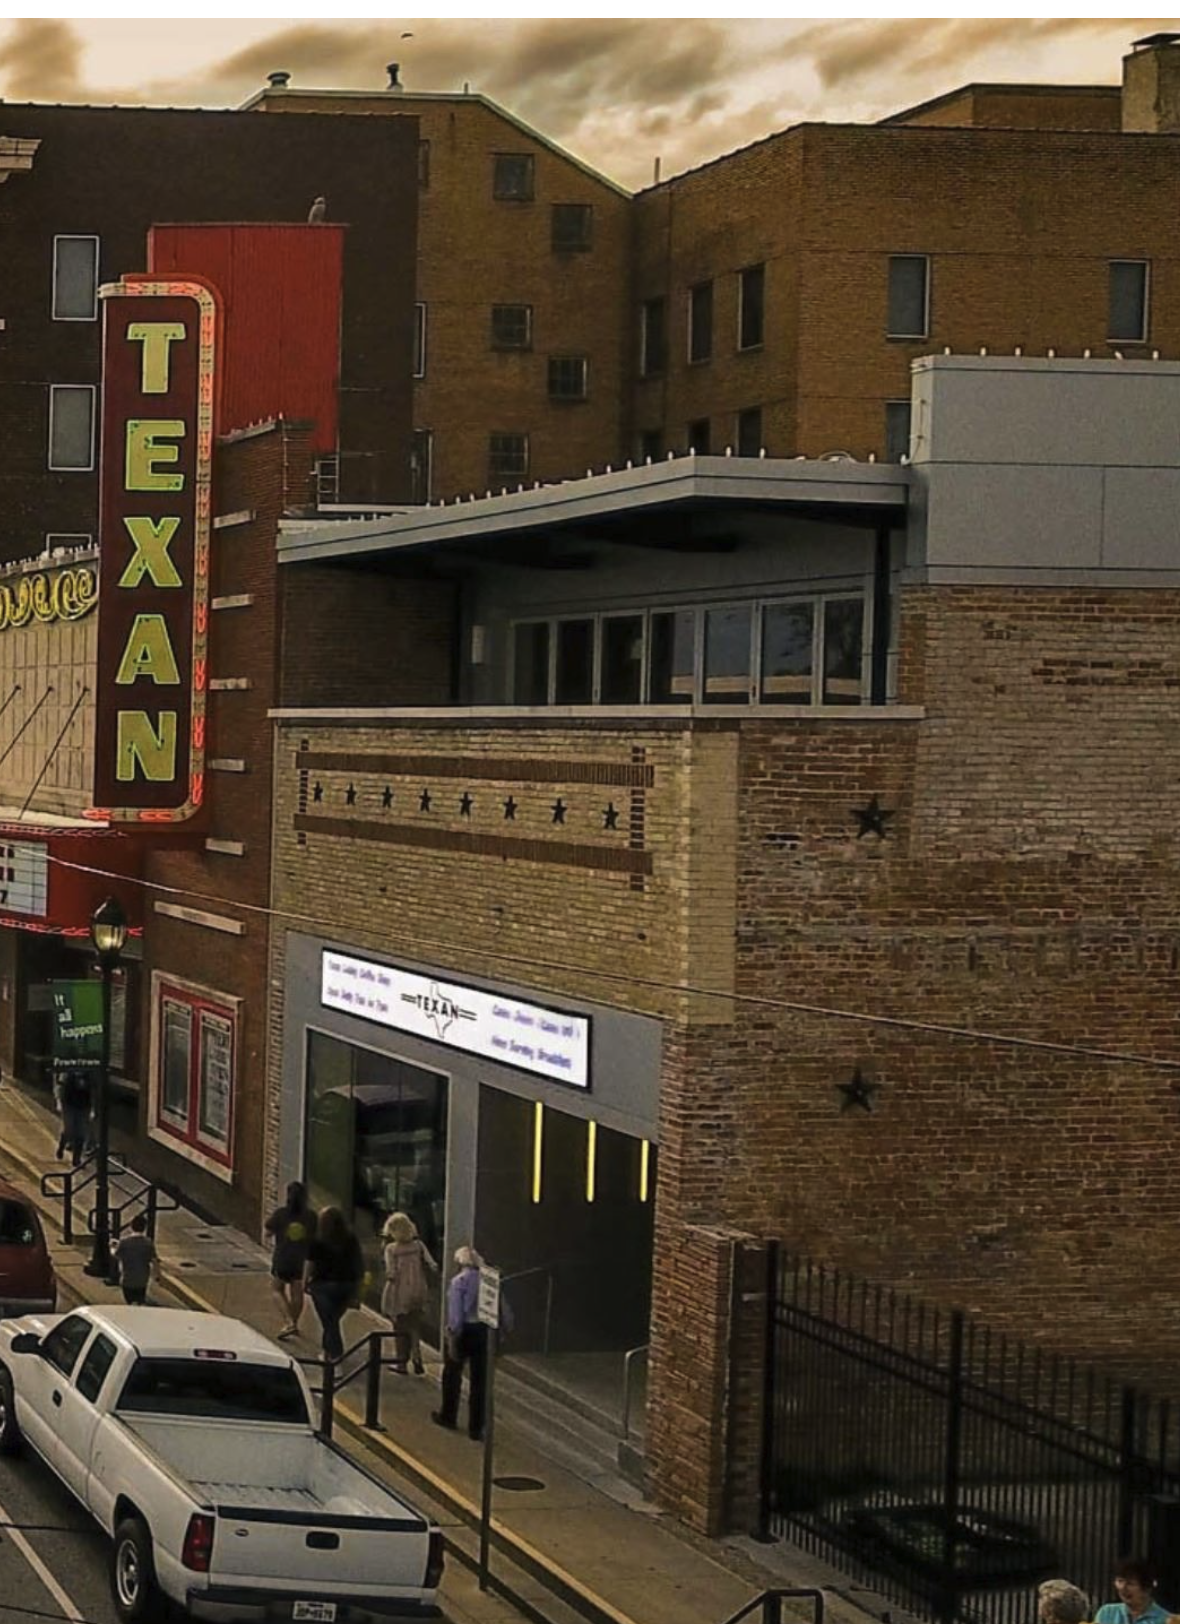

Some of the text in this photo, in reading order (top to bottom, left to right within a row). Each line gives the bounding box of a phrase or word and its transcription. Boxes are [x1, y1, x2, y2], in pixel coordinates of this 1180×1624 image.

[115, 322, 187, 782] TEXAN
[416, 993, 460, 1019] TEXAN
[61, 1023, 103, 1039] happens
